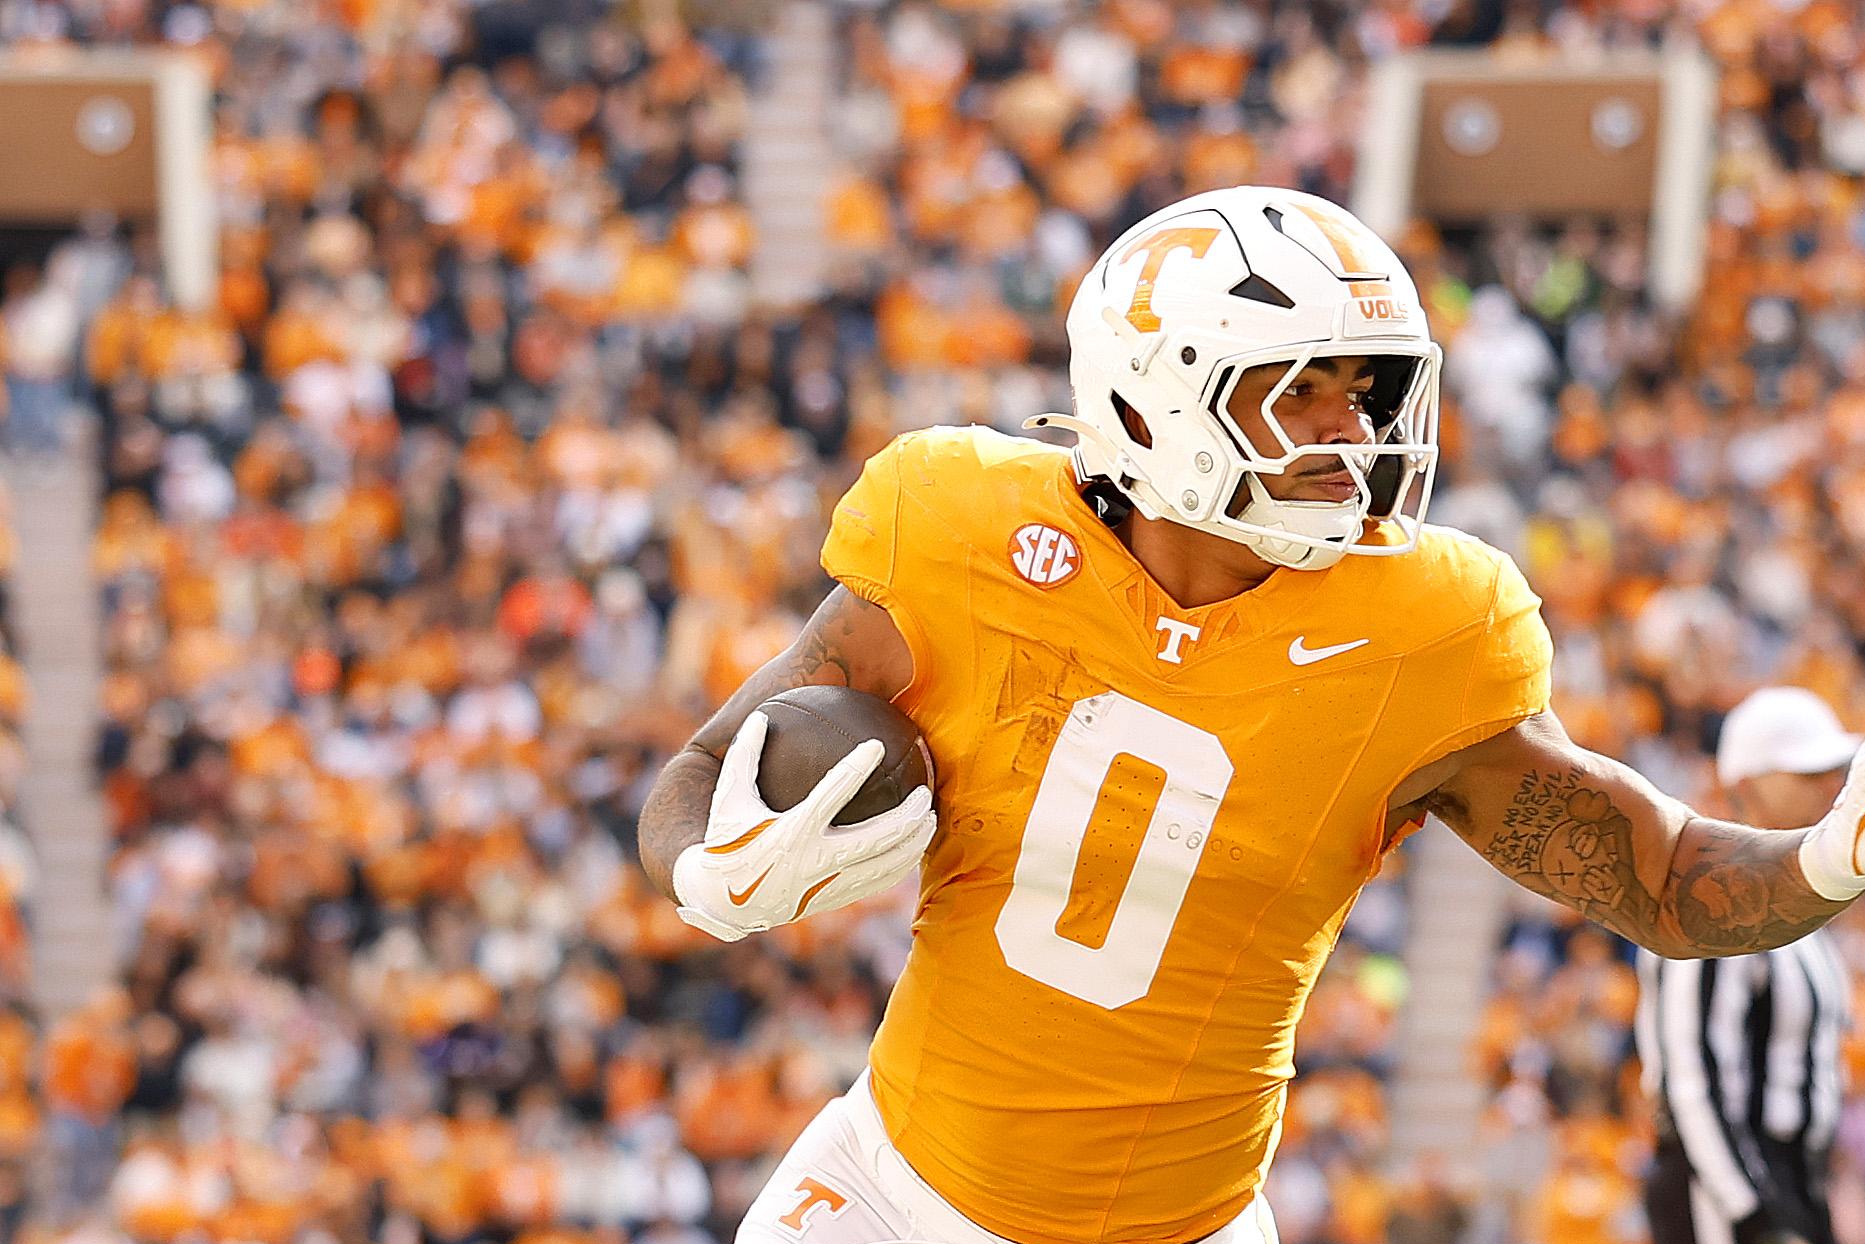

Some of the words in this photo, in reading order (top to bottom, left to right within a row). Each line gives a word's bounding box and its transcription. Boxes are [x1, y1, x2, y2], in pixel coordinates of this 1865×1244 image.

[1118, 227, 1222, 334] T
[1359, 300, 1409, 320] VOLS
[1011, 524, 1077, 583] SEC
[1155, 616, 1201, 664] T
[1503, 808, 1520, 827] NO
[1513, 769, 1539, 805] EVIL
[1519, 806, 1539, 826] NO
[1531, 772, 1561, 806] EVIL
[1545, 805, 1563, 821] NO
[994, 690, 1235, 1010] 0
[778, 1176, 848, 1231] T
